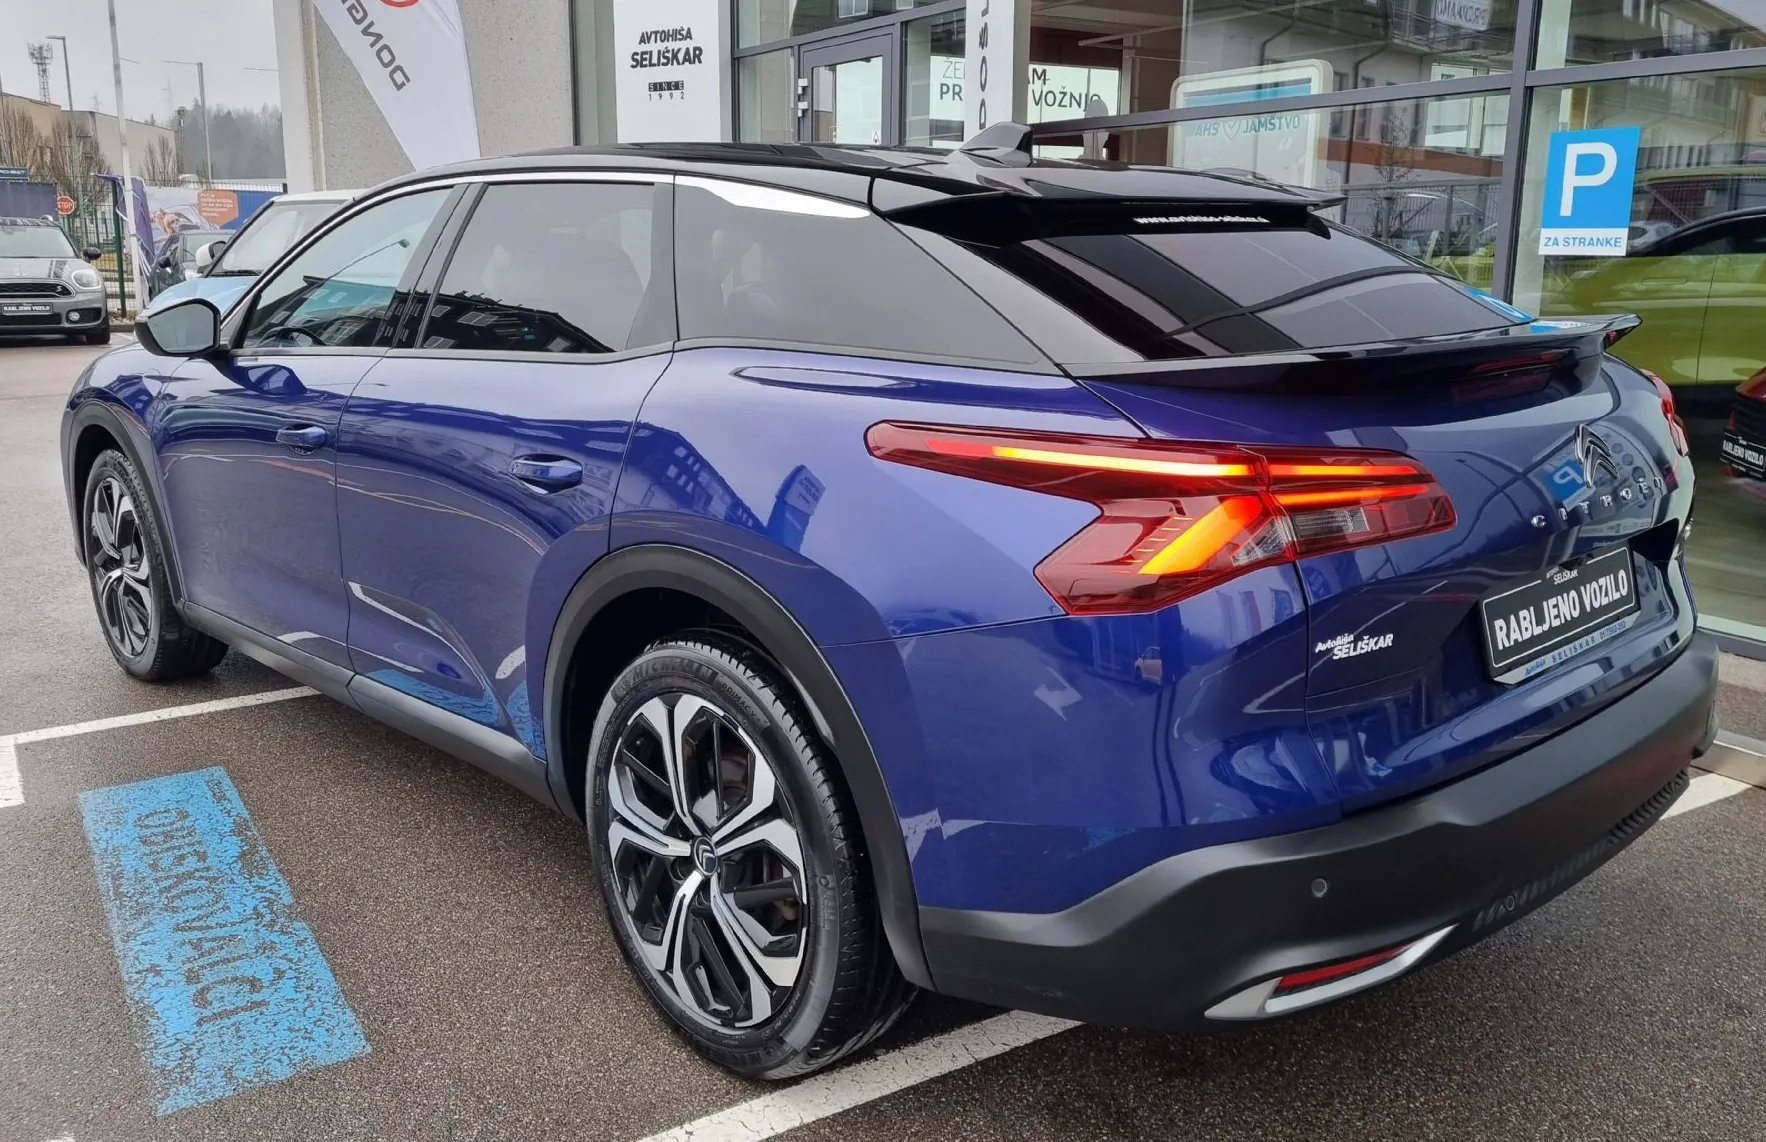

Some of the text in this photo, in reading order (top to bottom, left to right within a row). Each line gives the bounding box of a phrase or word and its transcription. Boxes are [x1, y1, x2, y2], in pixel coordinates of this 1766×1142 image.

[638, 26, 693, 45] AVTOHIŠA
[630, 46, 703, 69] SELIŠKAR
[943, 56, 966, 79] ŽE
[649, 81, 684, 91] SINCE
[649, 91, 685, 101] 1992
[1243, 114, 1300, 134] JAMSTVO
[1560, 142, 1618, 217] P
[58, 202, 73, 210] STOP
[1544, 236, 1622, 248] ZA STRANKE
[1494, 569, 1628, 651] RABLJENO VOZILO
[1332, 633, 1394, 660] SELIŠKAR
